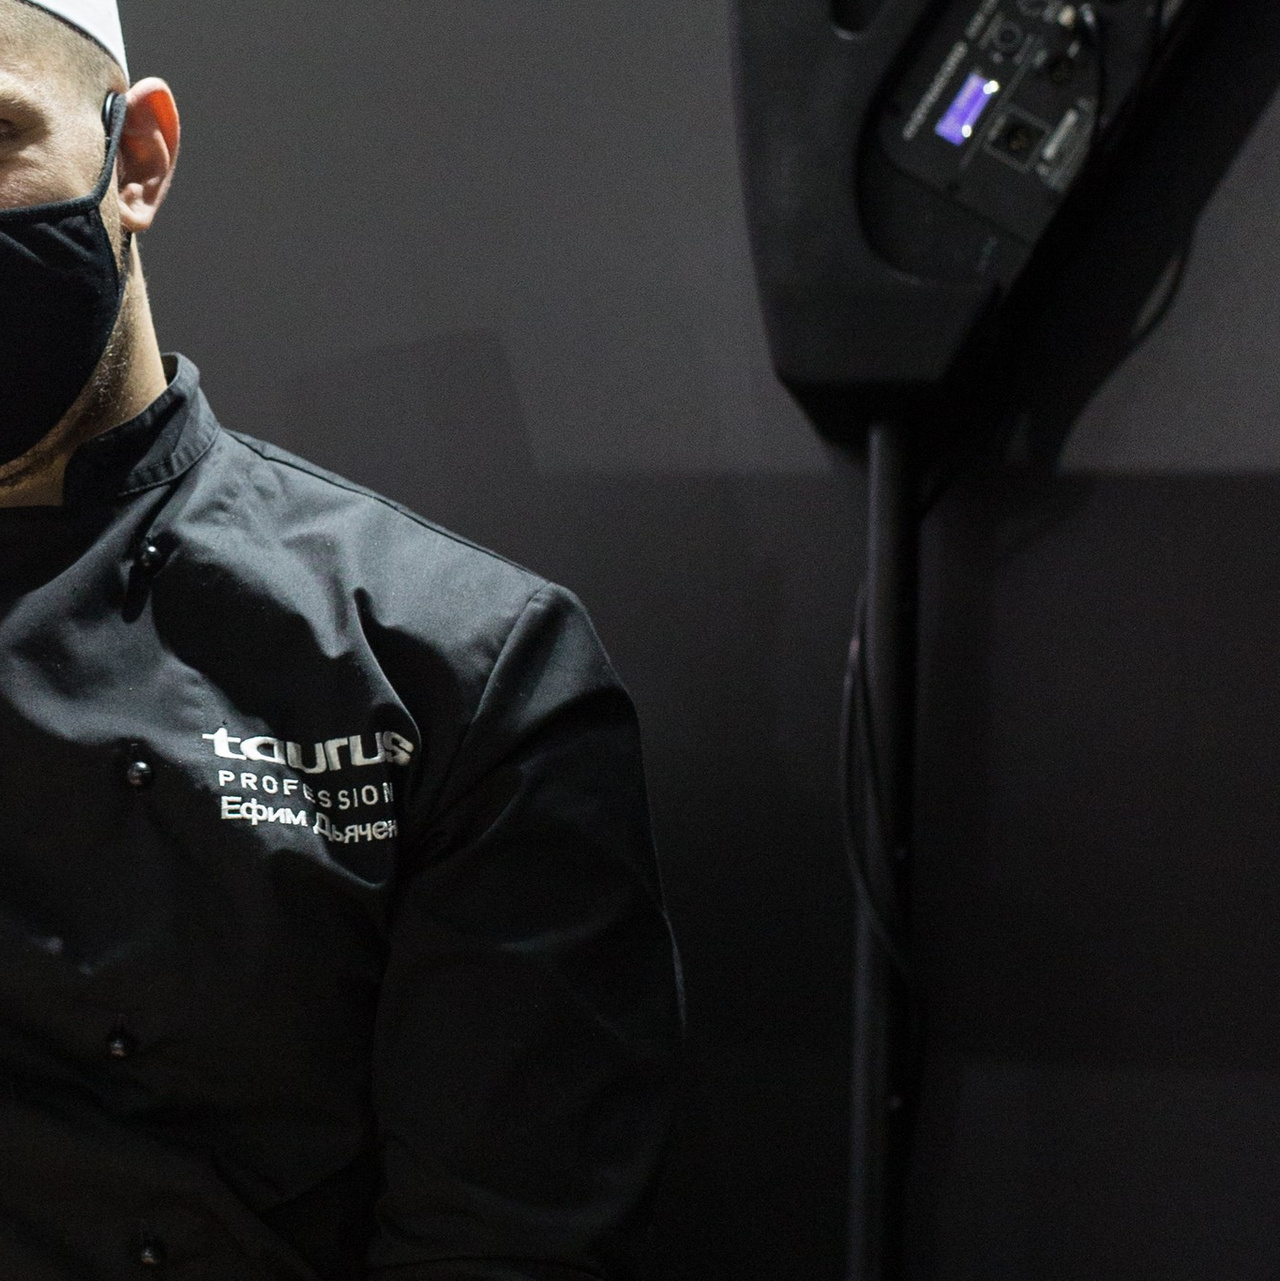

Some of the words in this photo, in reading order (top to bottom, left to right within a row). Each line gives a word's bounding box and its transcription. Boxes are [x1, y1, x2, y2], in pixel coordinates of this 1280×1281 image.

[201, 727, 414, 773] taurus
[218, 770, 394, 810] PROFESSION
[220, 795, 308, 826] Ефим
[312, 811, 398, 844] Дьячен
